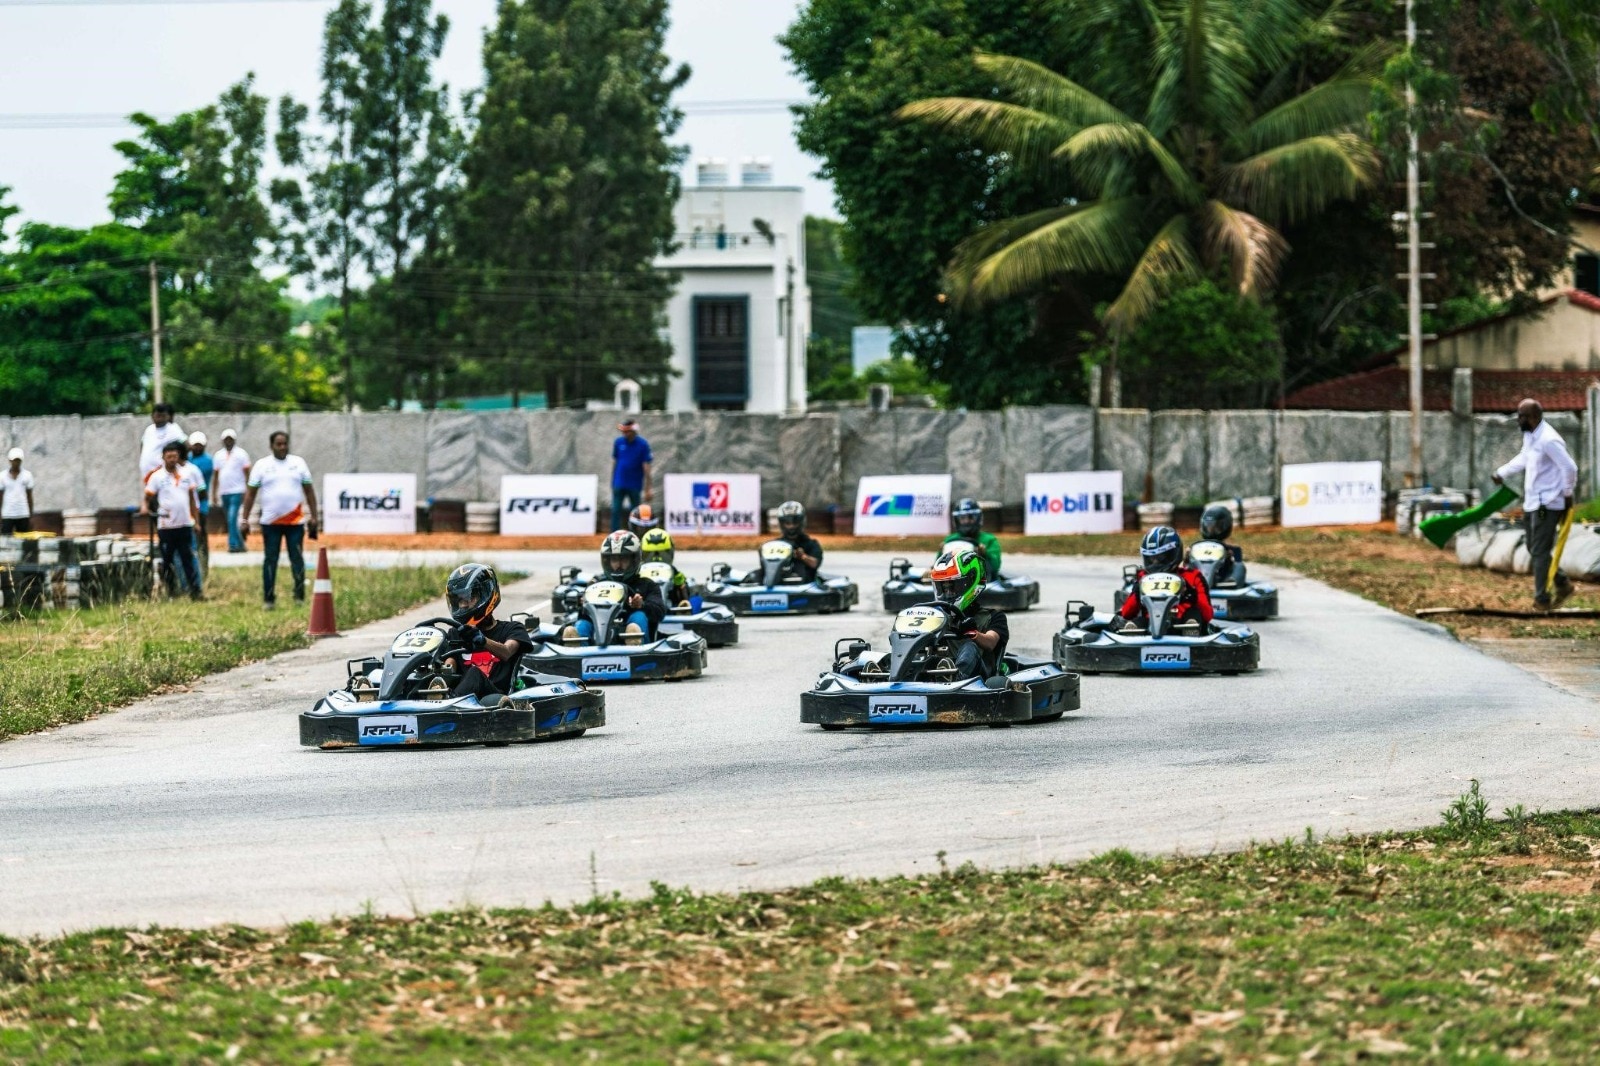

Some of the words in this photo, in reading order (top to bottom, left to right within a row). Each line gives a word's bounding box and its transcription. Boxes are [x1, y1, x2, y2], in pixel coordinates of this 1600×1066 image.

[1313, 481, 1376, 499] FLYTTA
[507, 497, 590, 512] RPPL
[1030, 494, 1088, 513] Mobil
[669, 510, 754, 527] NETWORK
[1151, 582, 1171, 591] 11
[598, 589, 611, 598] 2
[908, 616, 927, 627] 3
[399, 637, 431, 648] 13
[1144, 653, 1188, 662] RPPL
[585, 663, 628, 674] RPPL
[872, 704, 925, 715] RPPL
[362, 724, 415, 736] RPPL
